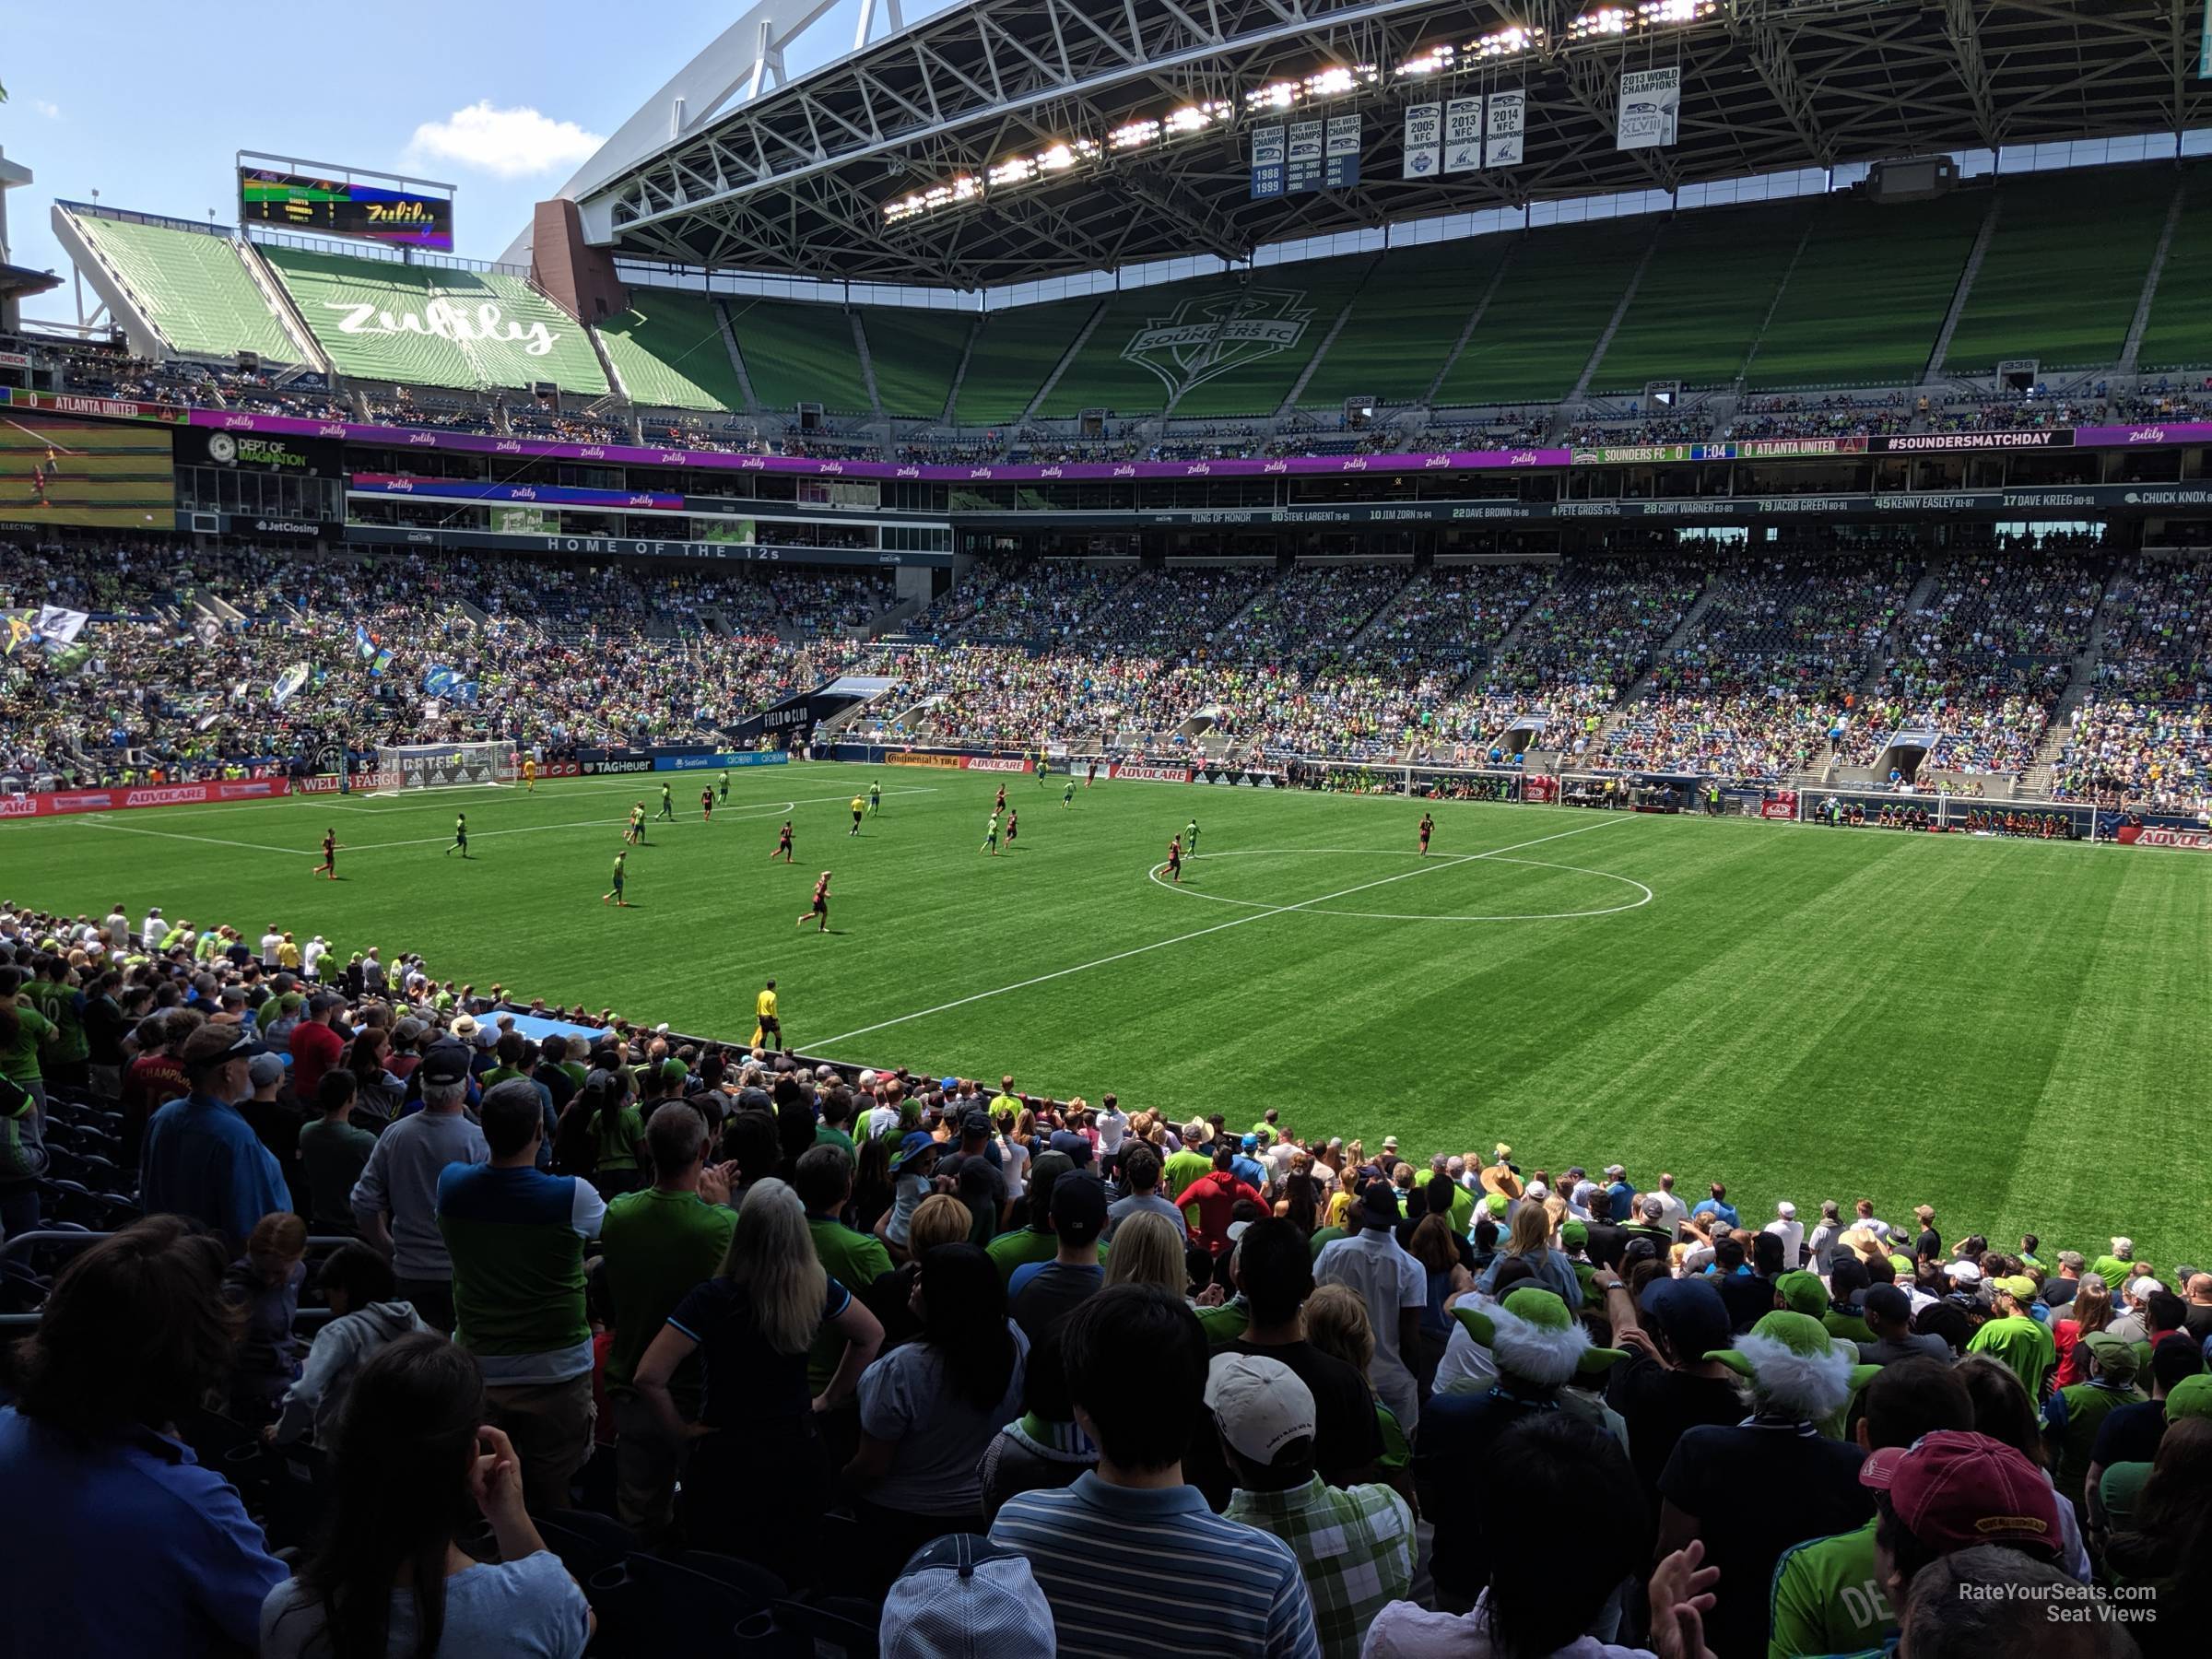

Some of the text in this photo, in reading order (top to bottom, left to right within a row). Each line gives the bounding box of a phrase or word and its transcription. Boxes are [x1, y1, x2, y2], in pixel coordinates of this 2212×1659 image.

[1623, 69, 1677, 86] 2013 WORLD
[1622, 79, 1677, 95] CHAMPIONS
[1329, 116, 1360, 127] NFC WEST
[1452, 115, 1476, 128] 2013
[1494, 109, 1518, 122] 2014
[1267, 128, 1283, 136] WEST
[1304, 122, 1322, 130] WEST
[1328, 124, 1359, 136] CHAMPS
[1411, 120, 1434, 133] 2005
[1455, 127, 1472, 136] NFC
[1497, 121, 1514, 132] NFC
[1620, 120, 1660, 134] XLVIII
[1253, 136, 1284, 147] CHAMPS
[1290, 130, 1321, 142] CHAMPS
[1414, 132, 1430, 142] NFC
[1446, 135, 1480, 147] CHAMPIONS
[1488, 130, 1523, 141] CHAMPIONS
[1406, 140, 1439, 151] CHAMPIONS
[1328, 158, 1341, 166] 2013
[1256, 168, 1279, 180] 1988
[1256, 182, 1279, 194] 1999
[1140, 327, 1292, 349] SOUNDERS FC
[0, 355, 27, 365] DECK
[29, 393, 138, 417] 0 ATLANTA UNITED
[239, 438, 267, 451] DEPT
[269, 441, 286, 453] OF
[1888, 432, 2052, 450] #SOUNDERSMATCHDAY
[1605, 446, 1683, 462] SOUNDERS FC 0
[1702, 444, 1726, 458] 1:04
[1745, 440, 1836, 456] 0 ATLANTA UNITED
[239, 450, 306, 466] IMAGINATION
[1875, 497, 1974, 509] 45 KENNY EASLEY 81-87
[2003, 494, 2094, 506] 17 DAVE KRIEG 80-91
[2143, 492, 2176, 503] CHUCK
[2179, 491, 2206, 502] KNOX
[1558, 506, 1577, 516] PETE
[1577, 506, 1604, 516] GROSS
[1643, 504, 1657, 514] 28
[1658, 504, 1679, 514] CURT
[1680, 503, 1714, 513] WARNER
[1758, 500, 1772, 512] 79
[1772, 500, 1799, 512] JACOB
[1800, 500, 1829, 511] GREEN
[1192, 512, 1252, 524] RING OF HONOR
[1271, 512, 1284, 522] 80
[1283, 512, 1304, 522] STEVE
[1304, 511, 1334, 522] LARGENT
[1370, 510, 1382, 520] 10
[1382, 510, 1395, 520] JIM
[1397, 509, 1416, 520] ZORN
[1453, 508, 1465, 518] 22
[1465, 508, 1484, 518] DAVE
[1485, 507, 1512, 517] BROWN
[0, 523, 37, 532] ELECTRIC
[267, 521, 319, 535] JetClosing
[548, 538, 780, 560] HOME OF THE 12s
[764, 707, 807, 727] FIELD CLUB
[685, 759, 707, 767] SeatGeek
[888, 753, 931, 764] Continental
[969, 759, 1024, 771] ADVOCARE
[356, 772, 399, 788] FARGO
[1118, 767, 1186, 782] ADVOCARE
[127, 786, 206, 806] ADVOCARE
